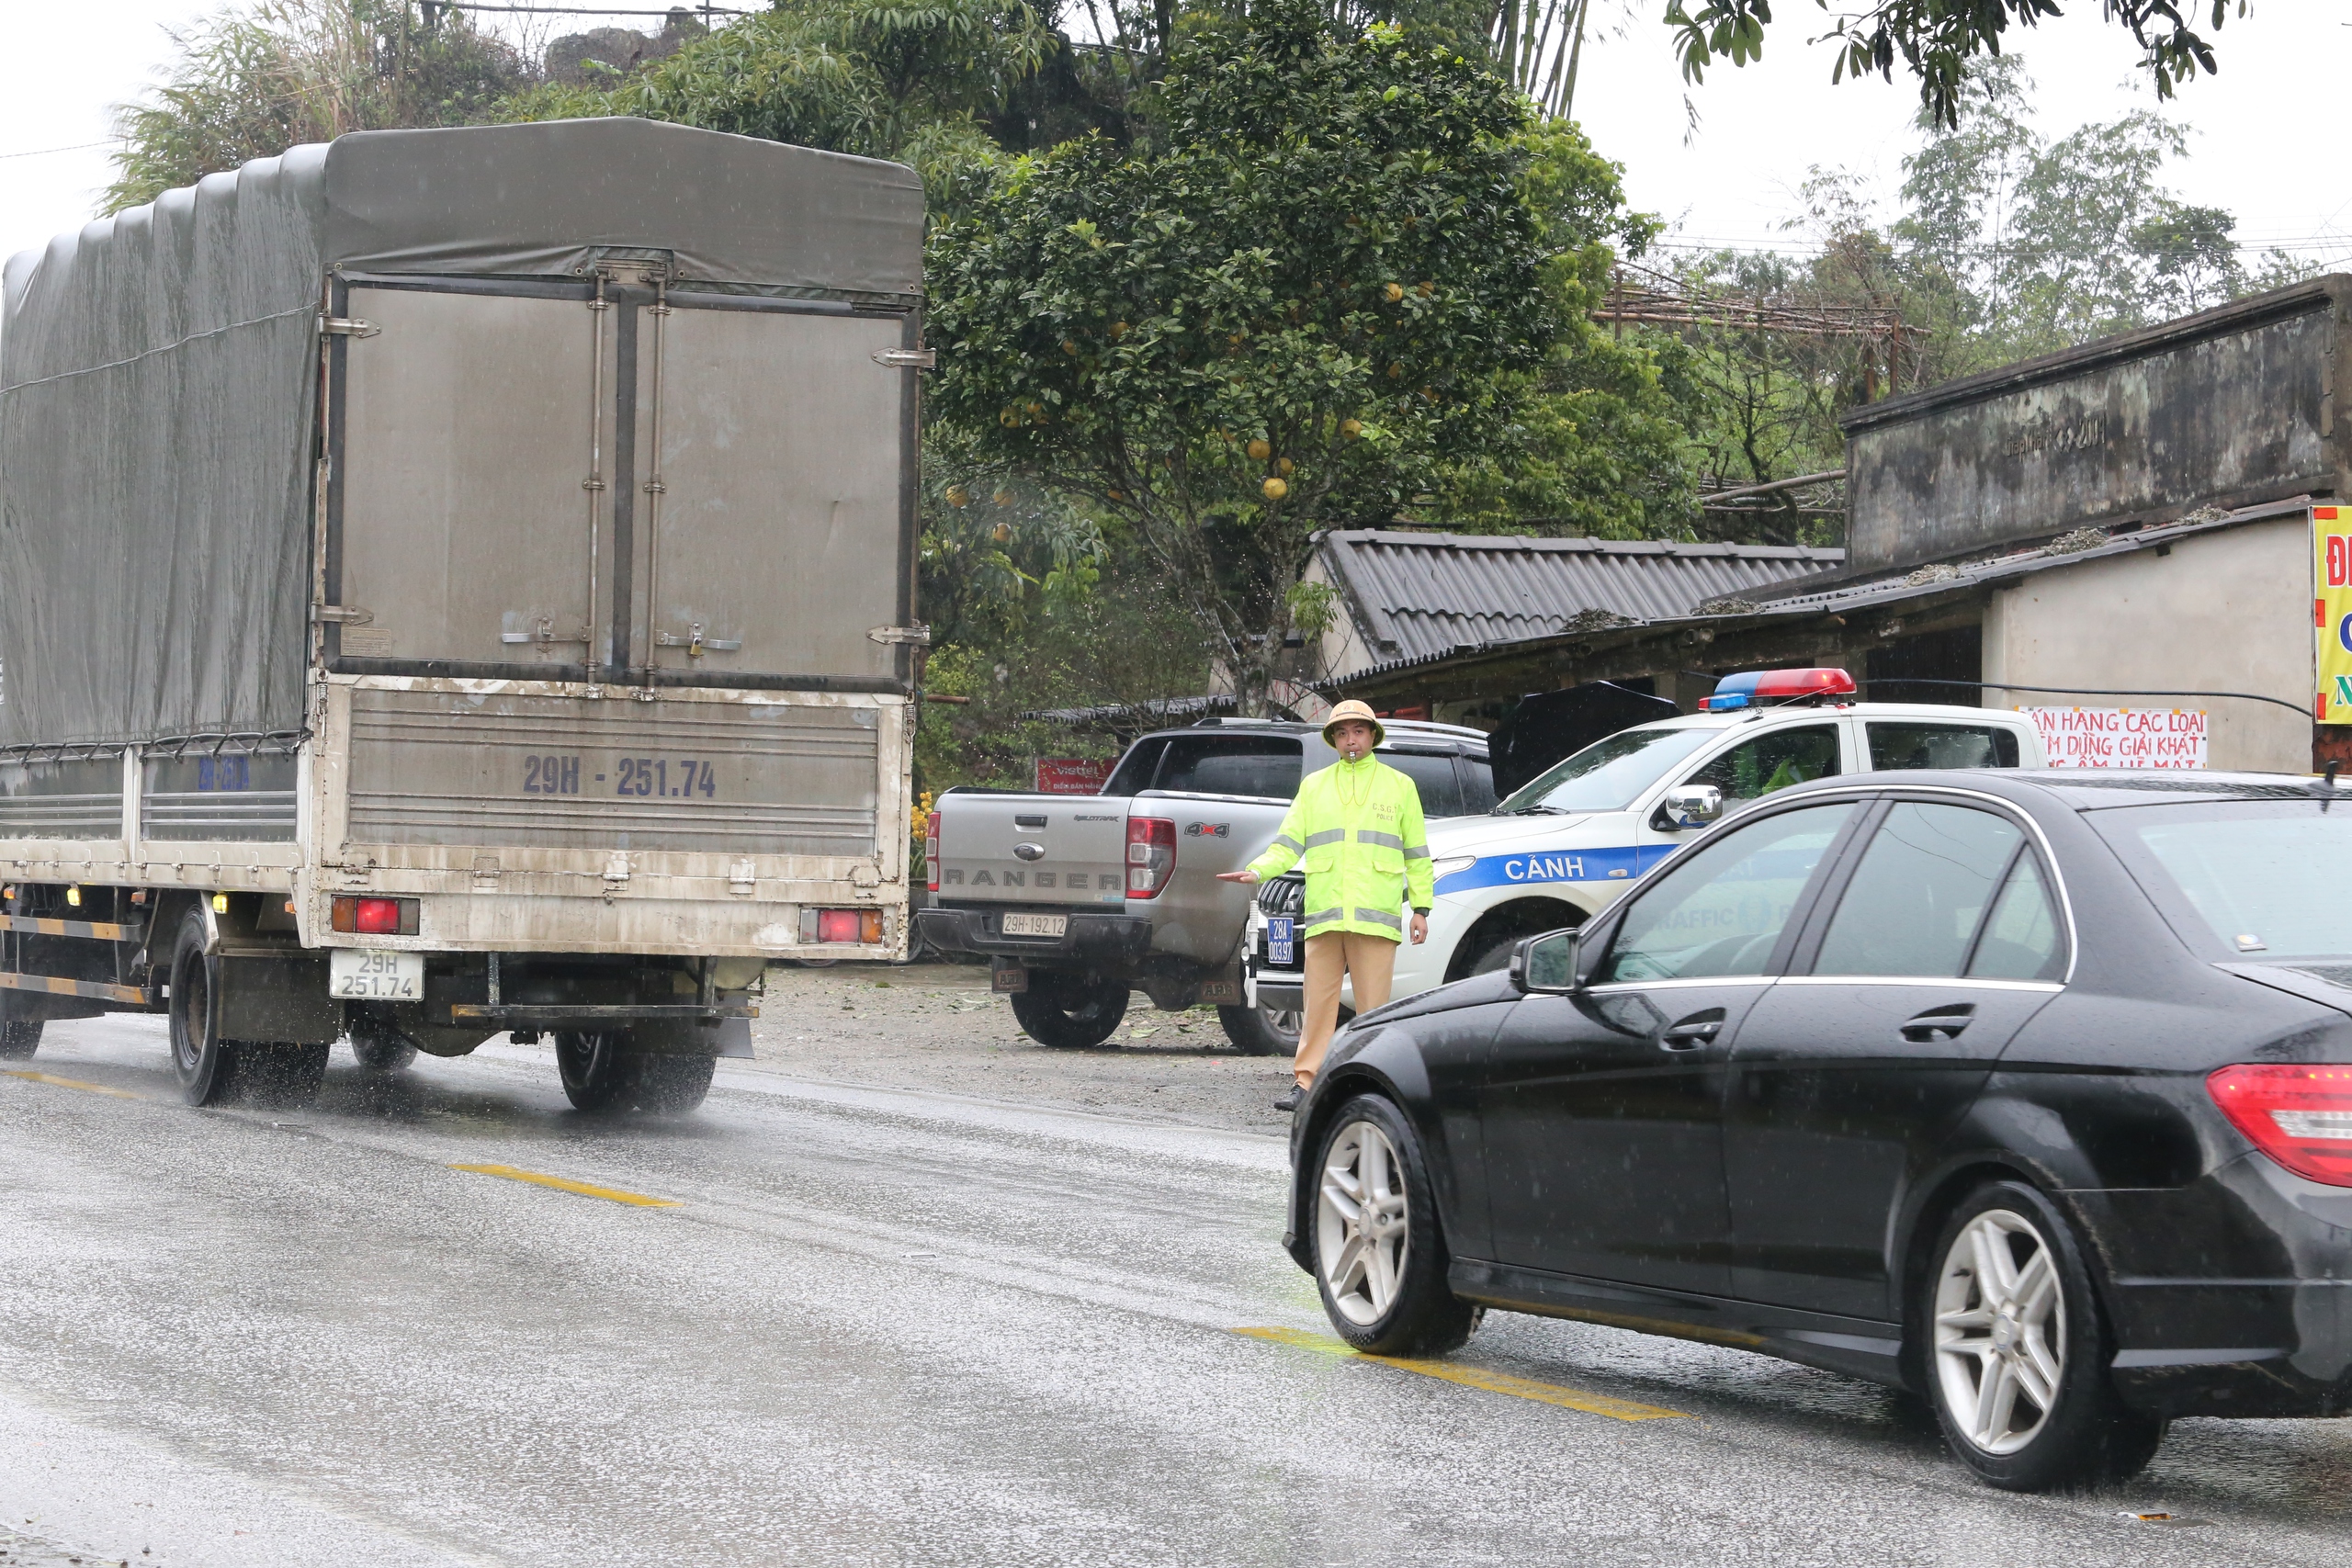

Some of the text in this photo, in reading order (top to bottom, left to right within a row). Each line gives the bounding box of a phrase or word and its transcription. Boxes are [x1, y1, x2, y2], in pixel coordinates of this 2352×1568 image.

[2126, 710, 2163, 732] CÁC
[2157, 732, 2199, 755] KHÁT
[523, 755, 579, 794] 29H
[617, 758, 716, 797] 251.74
[1376, 813, 1394, 822] POLICE
[1504, 853, 1586, 881] CẢNH
[944, 868, 1122, 891] RANGER
[1273, 919, 1287, 940] 28A
[1269, 941, 1292, 961] 003.97
[358, 953, 398, 974] 29H
[341, 976, 413, 997] 251.74
